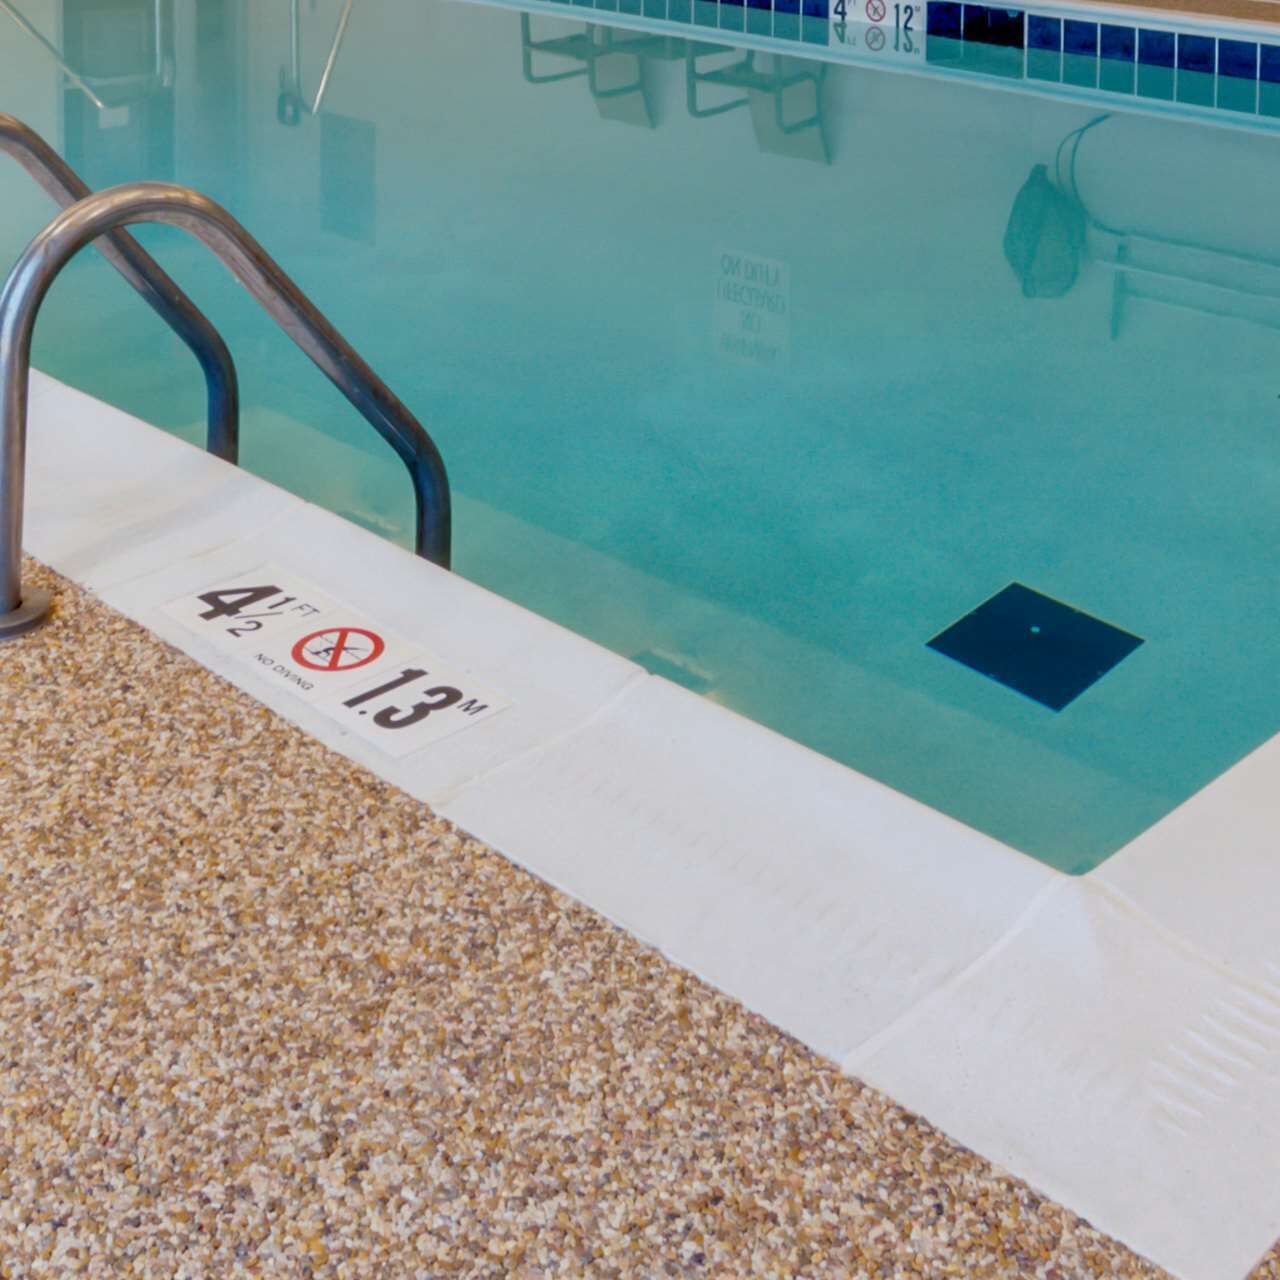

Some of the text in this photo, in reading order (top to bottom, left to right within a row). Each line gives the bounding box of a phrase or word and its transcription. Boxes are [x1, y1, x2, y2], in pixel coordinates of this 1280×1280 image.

[271, 663, 315, 691] DIVING
[290, 603, 320, 618] FT
[456, 698, 488, 717] M
